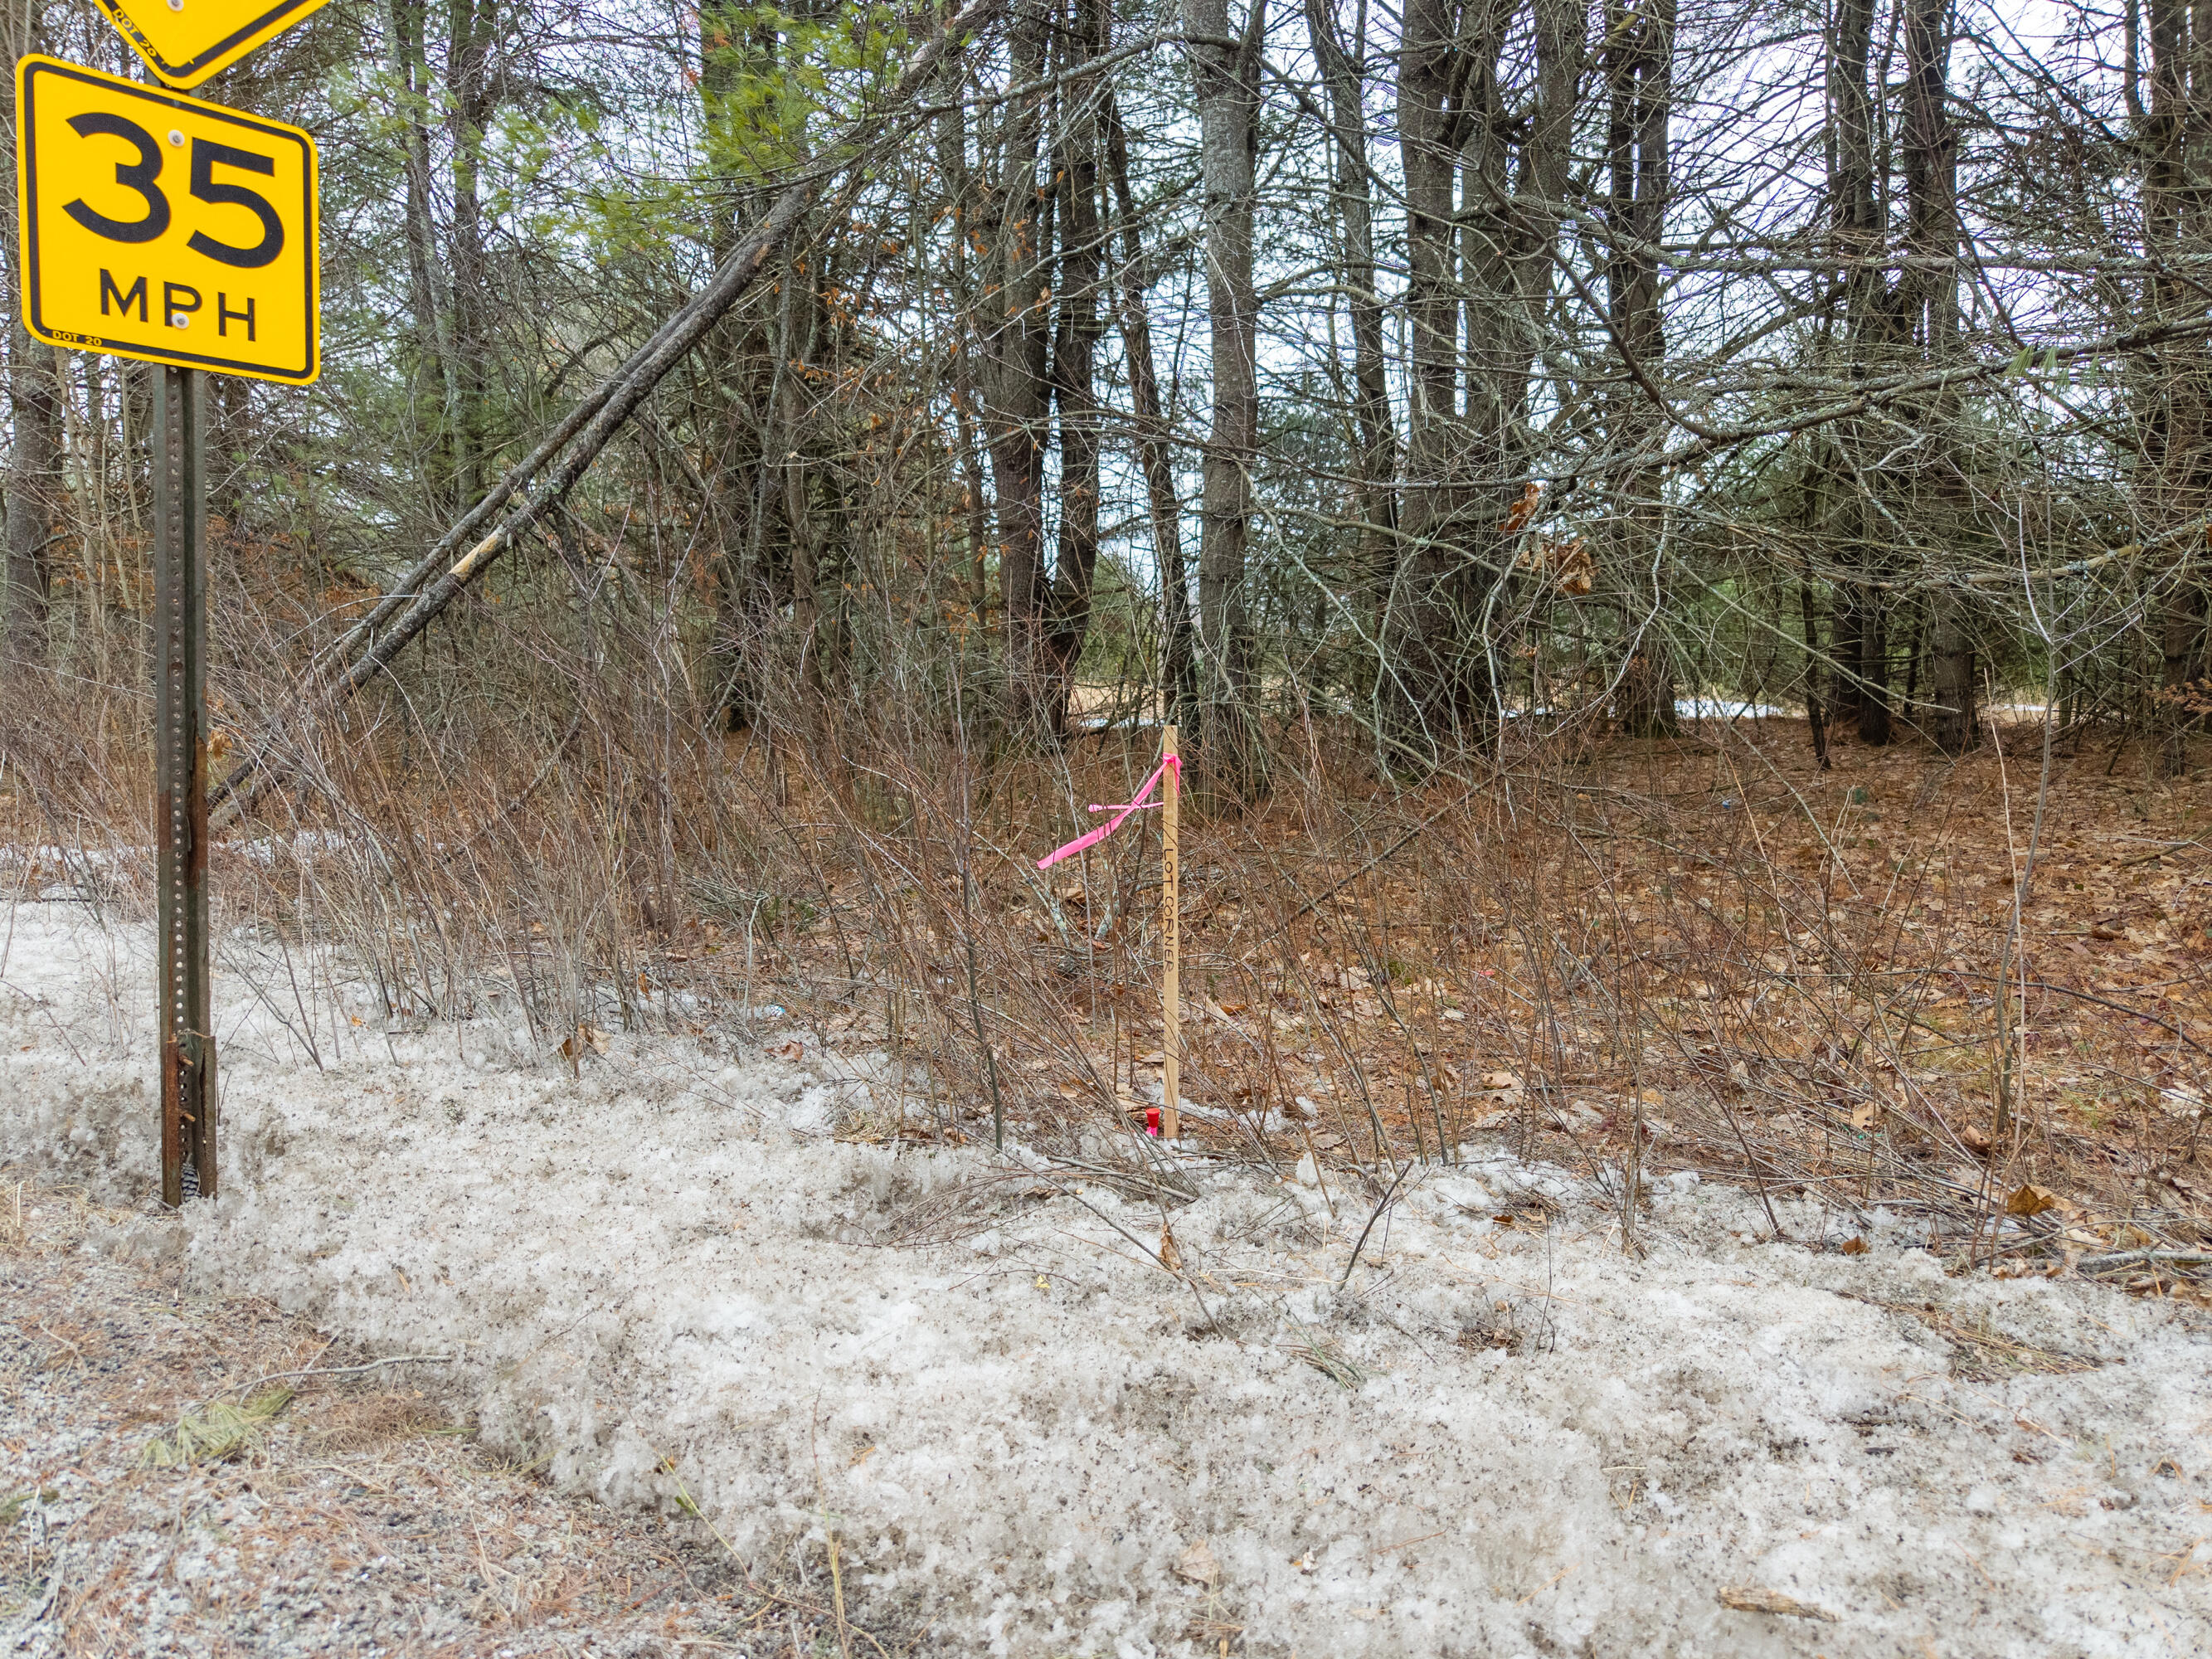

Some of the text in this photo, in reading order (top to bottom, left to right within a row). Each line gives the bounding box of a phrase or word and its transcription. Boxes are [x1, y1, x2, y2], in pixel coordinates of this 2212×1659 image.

[112, 7, 158, 57] DOT 20
[62, 112, 284, 269] 35
[52, 330, 103, 347] DOT 20
[100, 268, 256, 342] MPH
[1163, 848, 1174, 973] LOT CORNER
